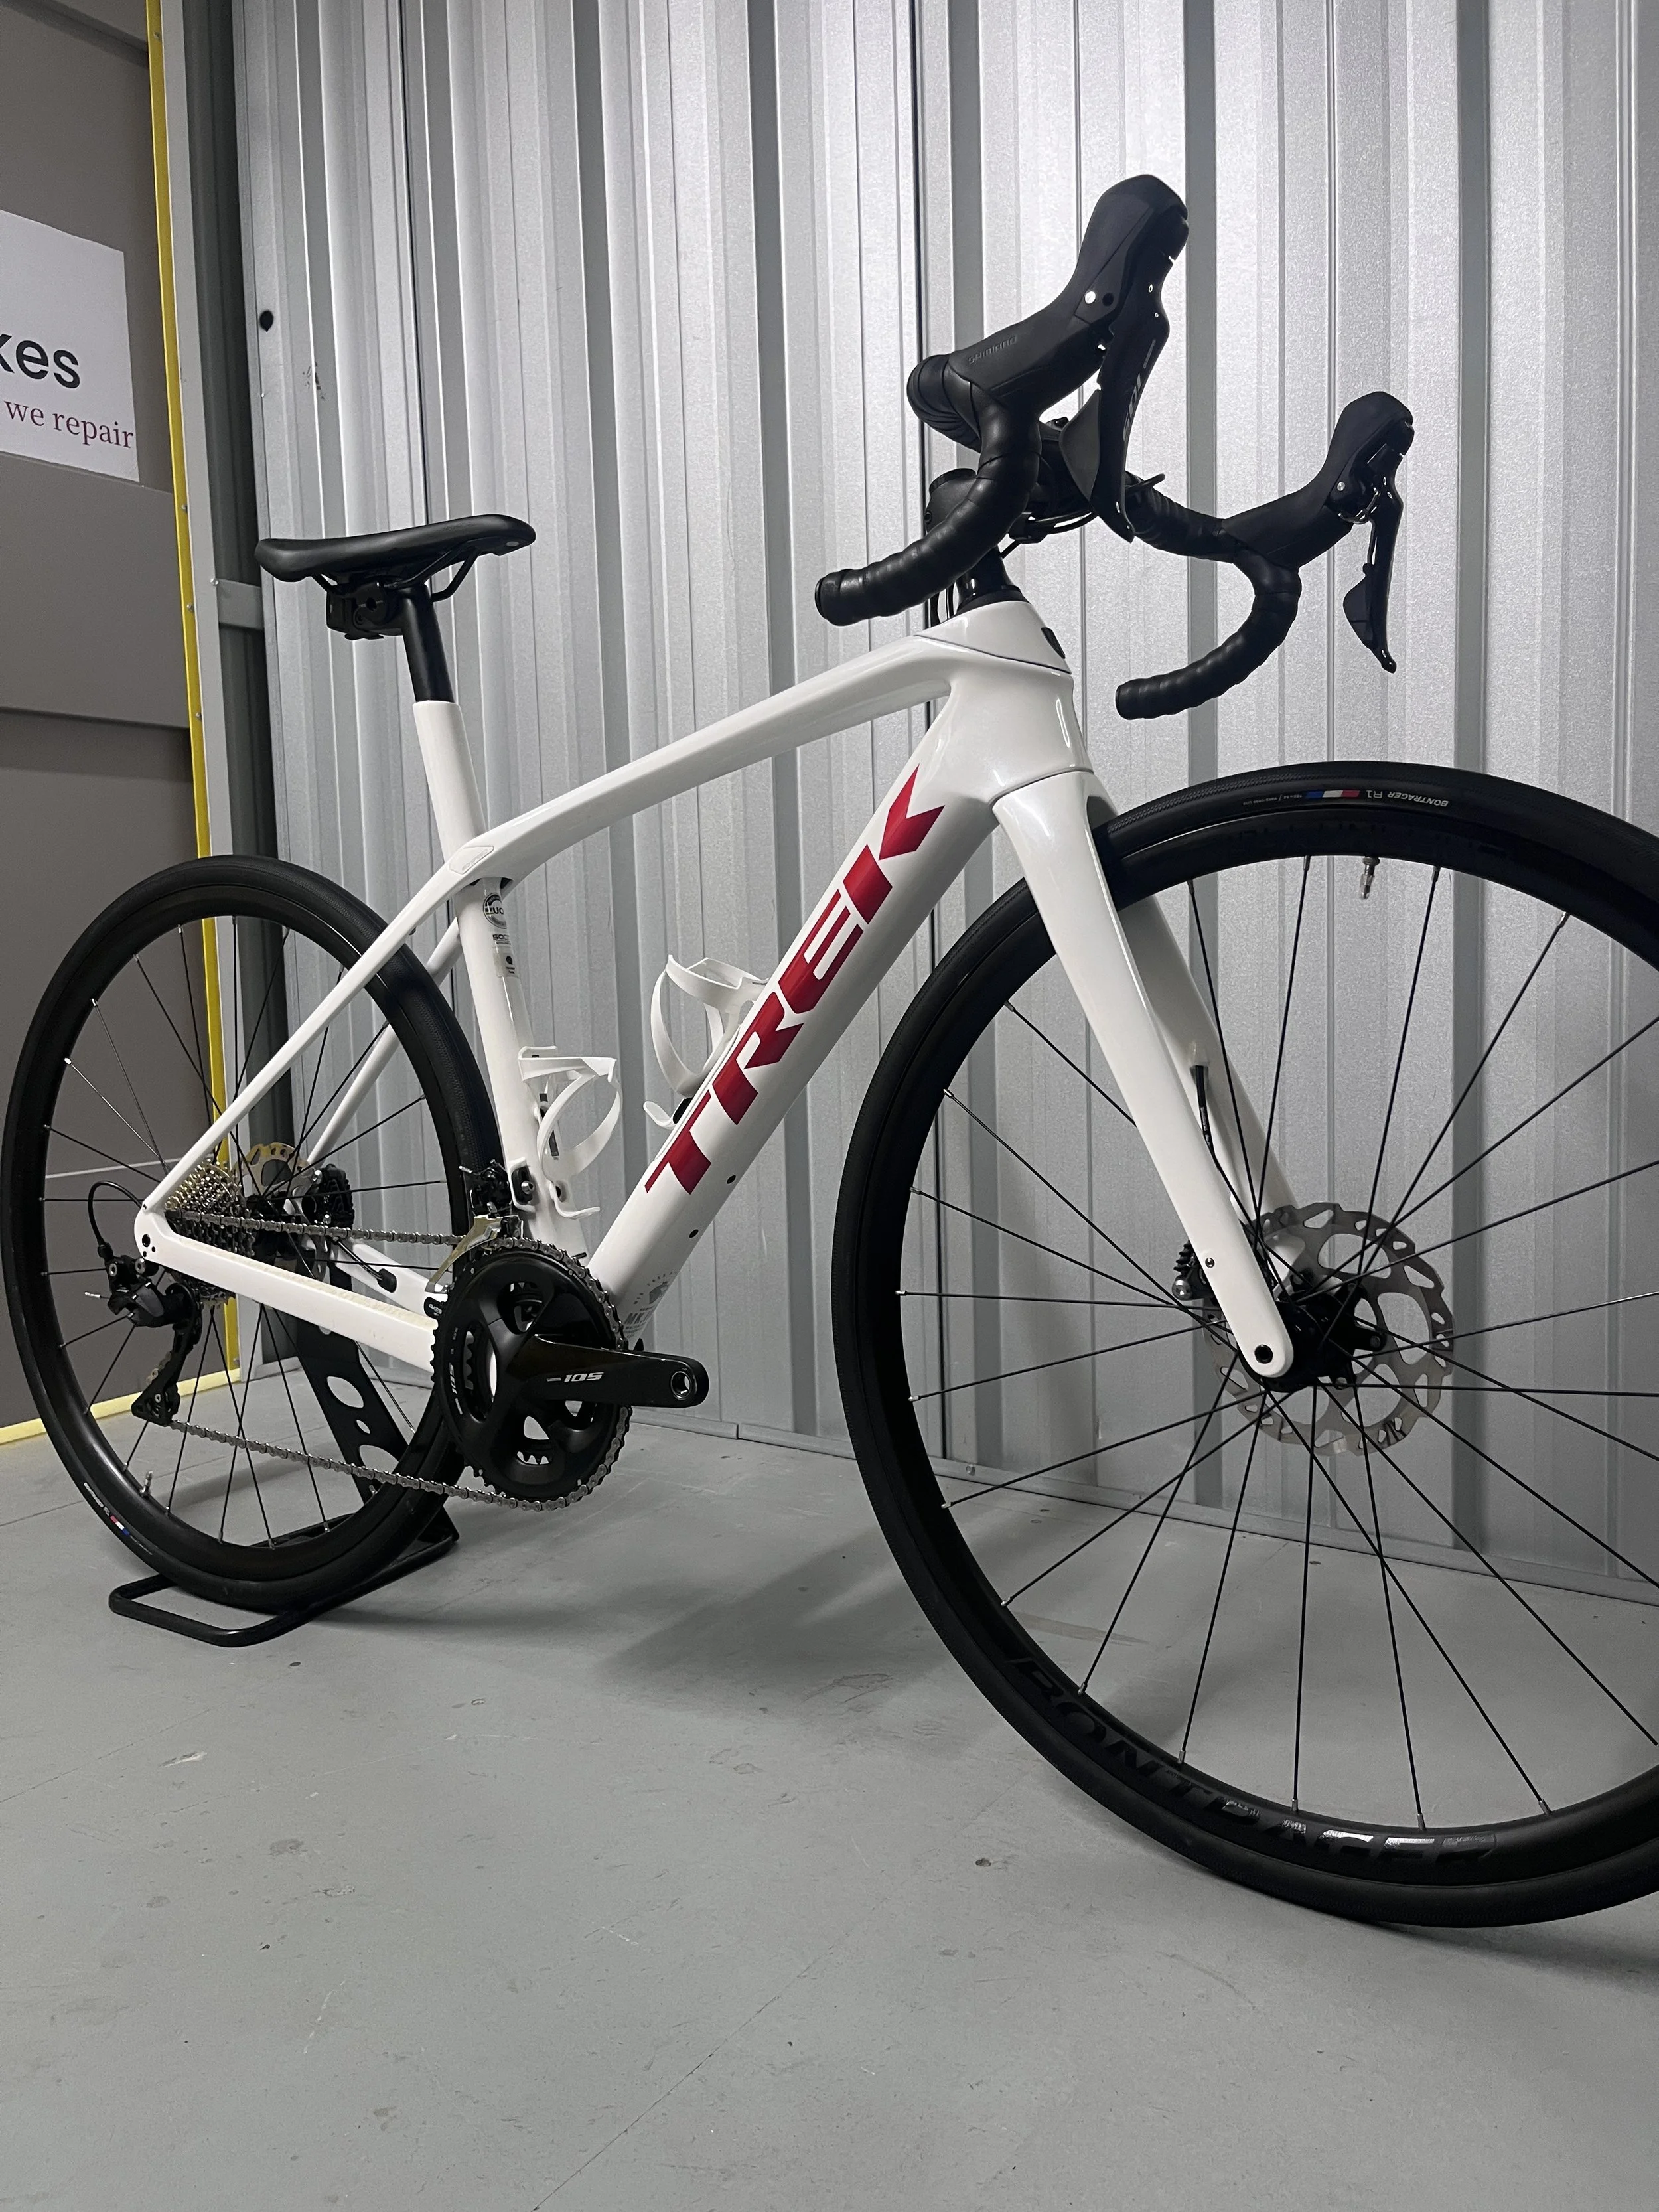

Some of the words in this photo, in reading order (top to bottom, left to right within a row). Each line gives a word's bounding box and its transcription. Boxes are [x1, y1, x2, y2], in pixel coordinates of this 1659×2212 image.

[968, 334, 1018, 365] SHIMANO
[4, 400, 44, 427] we
[52, 413, 134, 449] repair
[1366, 790, 1383, 799] R1
[1387, 790, 1449, 808] BONTRAGER
[645, 764, 944, 1195] TREK
[564, 1372, 605, 1382] 105
